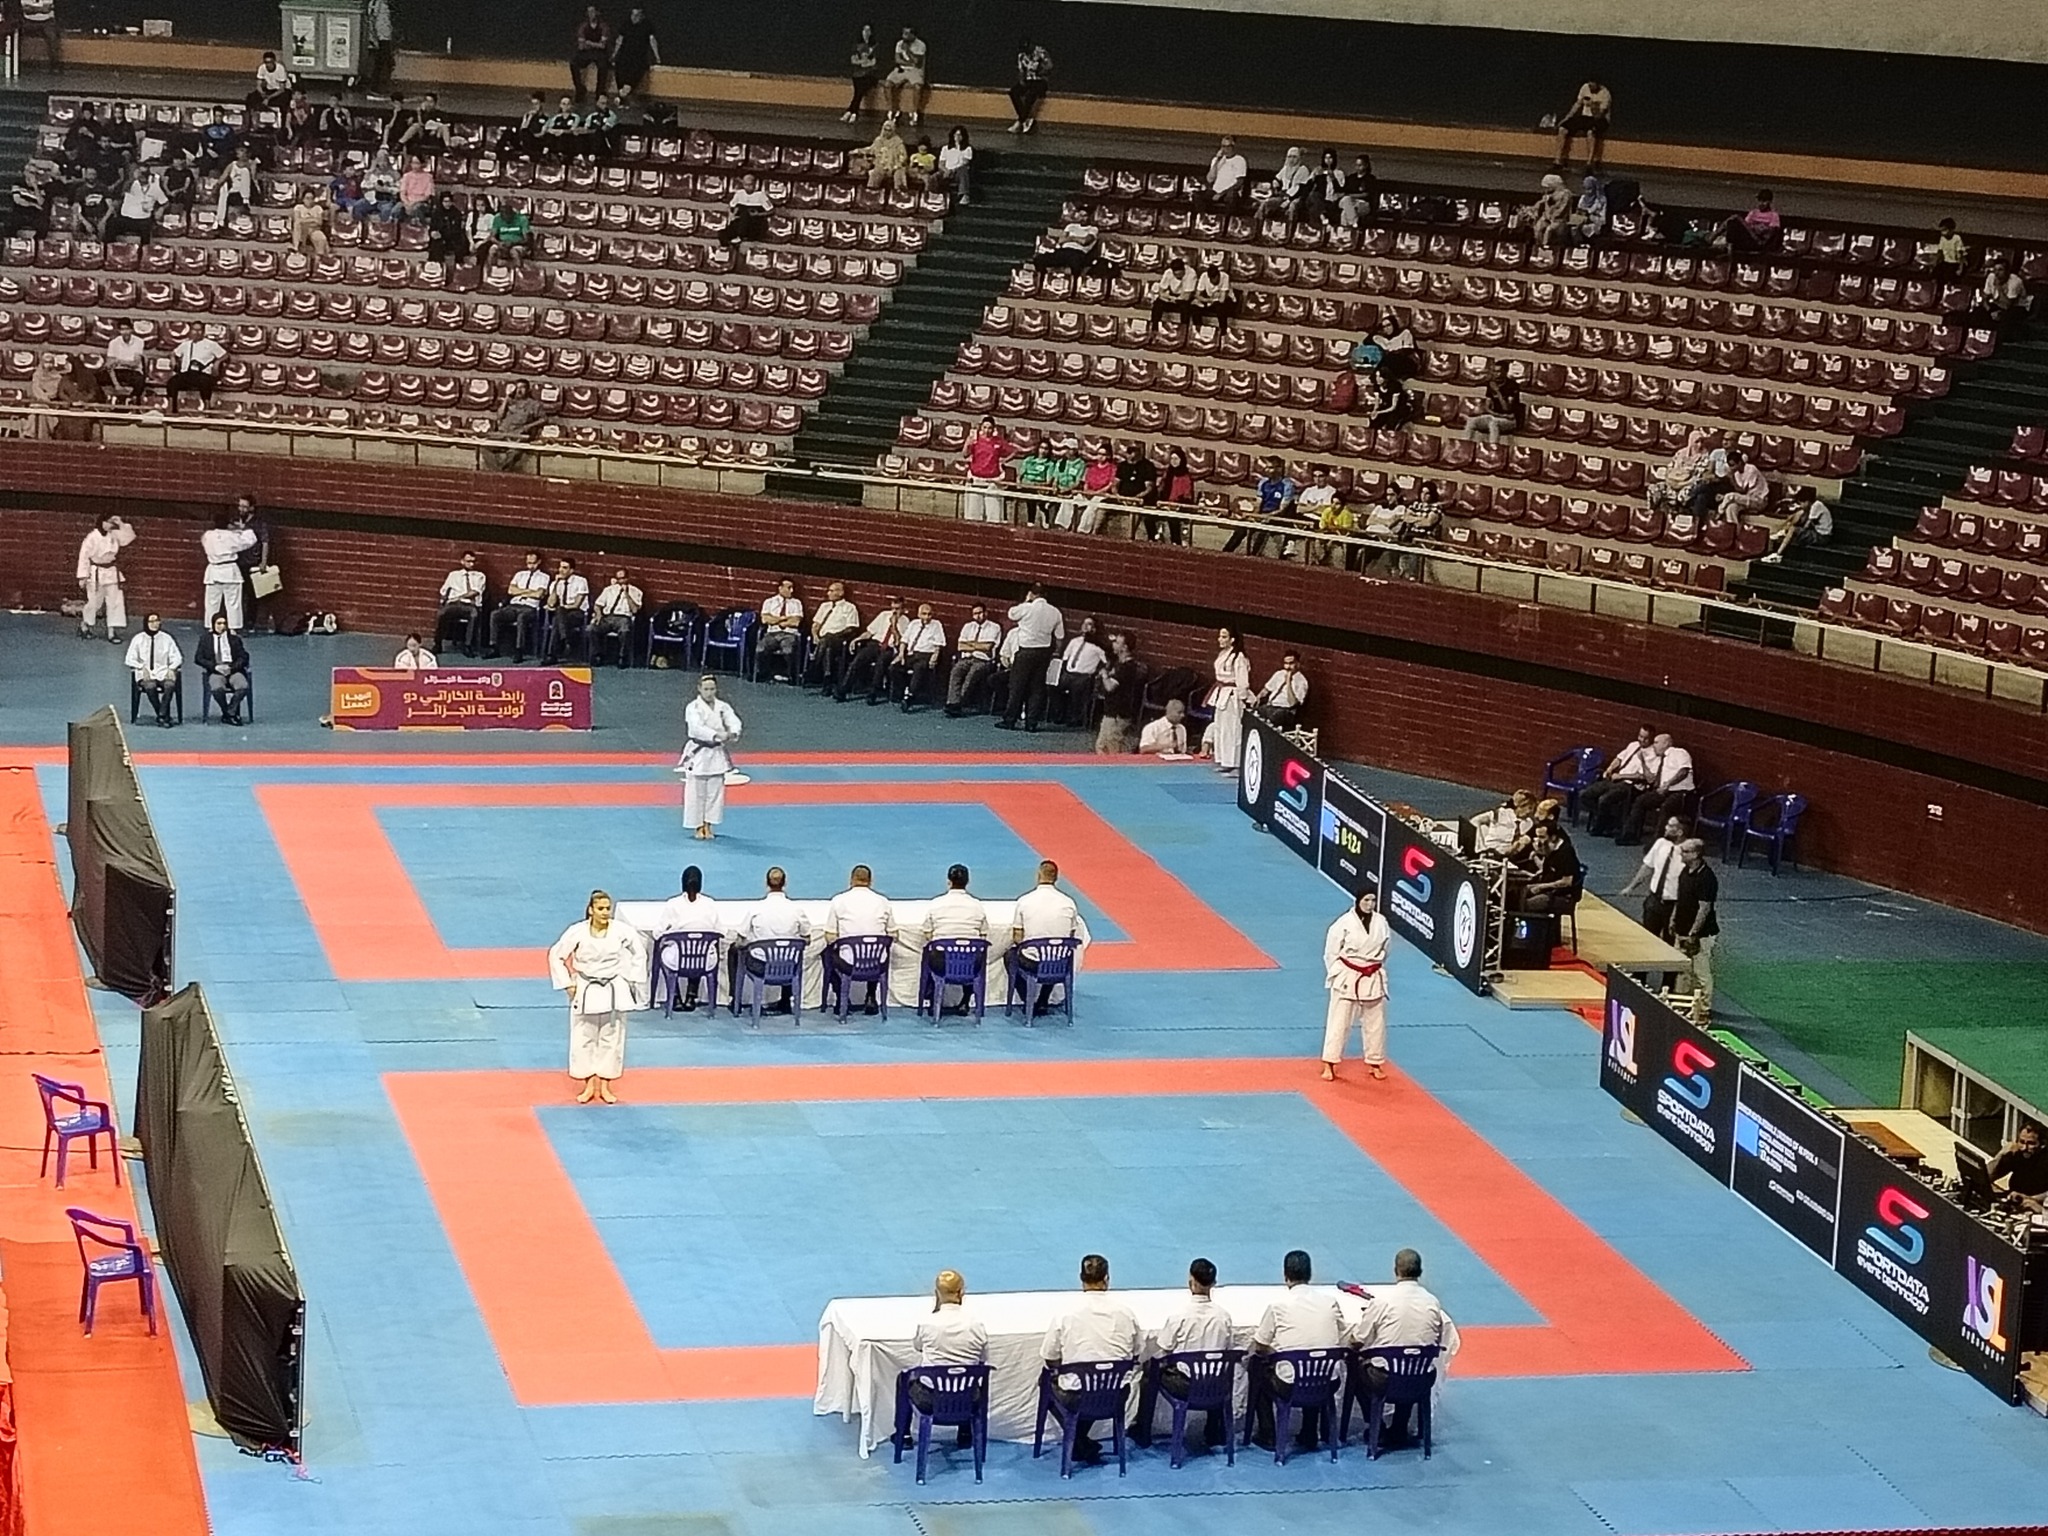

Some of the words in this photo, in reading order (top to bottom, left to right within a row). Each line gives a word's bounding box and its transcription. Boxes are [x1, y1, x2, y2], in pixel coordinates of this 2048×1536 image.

[403, 692, 418, 704] دو
[420, 690, 474, 706] الكاراتي
[475, 690, 525, 704] رابطة
[407, 703, 476, 718] الجزائر
[477, 704, 525, 718] لولاية
[1657, 1088, 1715, 1143] SPORTDATA
[1857, 1238, 1930, 1303] SPORTDATA
